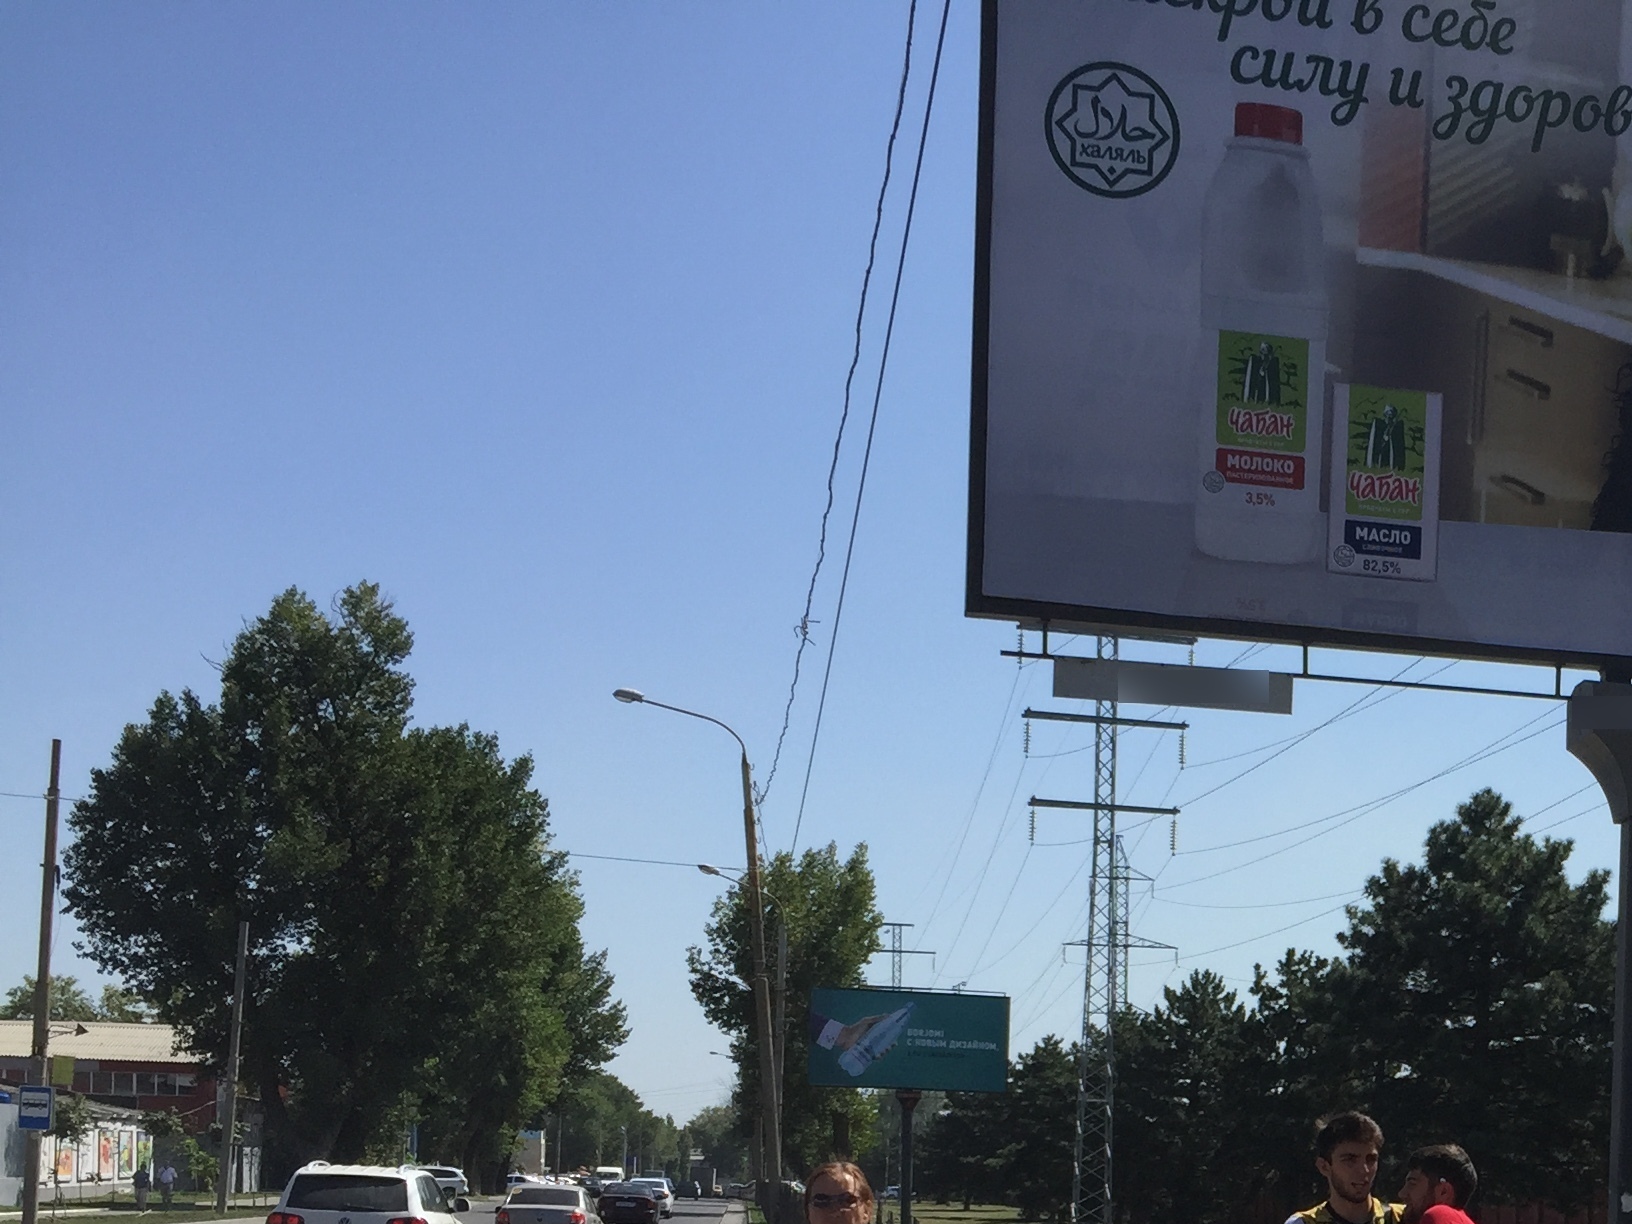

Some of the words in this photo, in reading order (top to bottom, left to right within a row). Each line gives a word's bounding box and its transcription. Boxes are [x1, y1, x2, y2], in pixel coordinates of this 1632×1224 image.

[1402, 1, 1518, 55] себе
[1229, 45, 1371, 127] силу
[1388, 67, 1424, 109] и
[1226, 453, 1295, 474] МОЛОКО
[1355, 526, 1412, 545] МАСЛО
[1362, 559, 1402, 575] 82,5%
